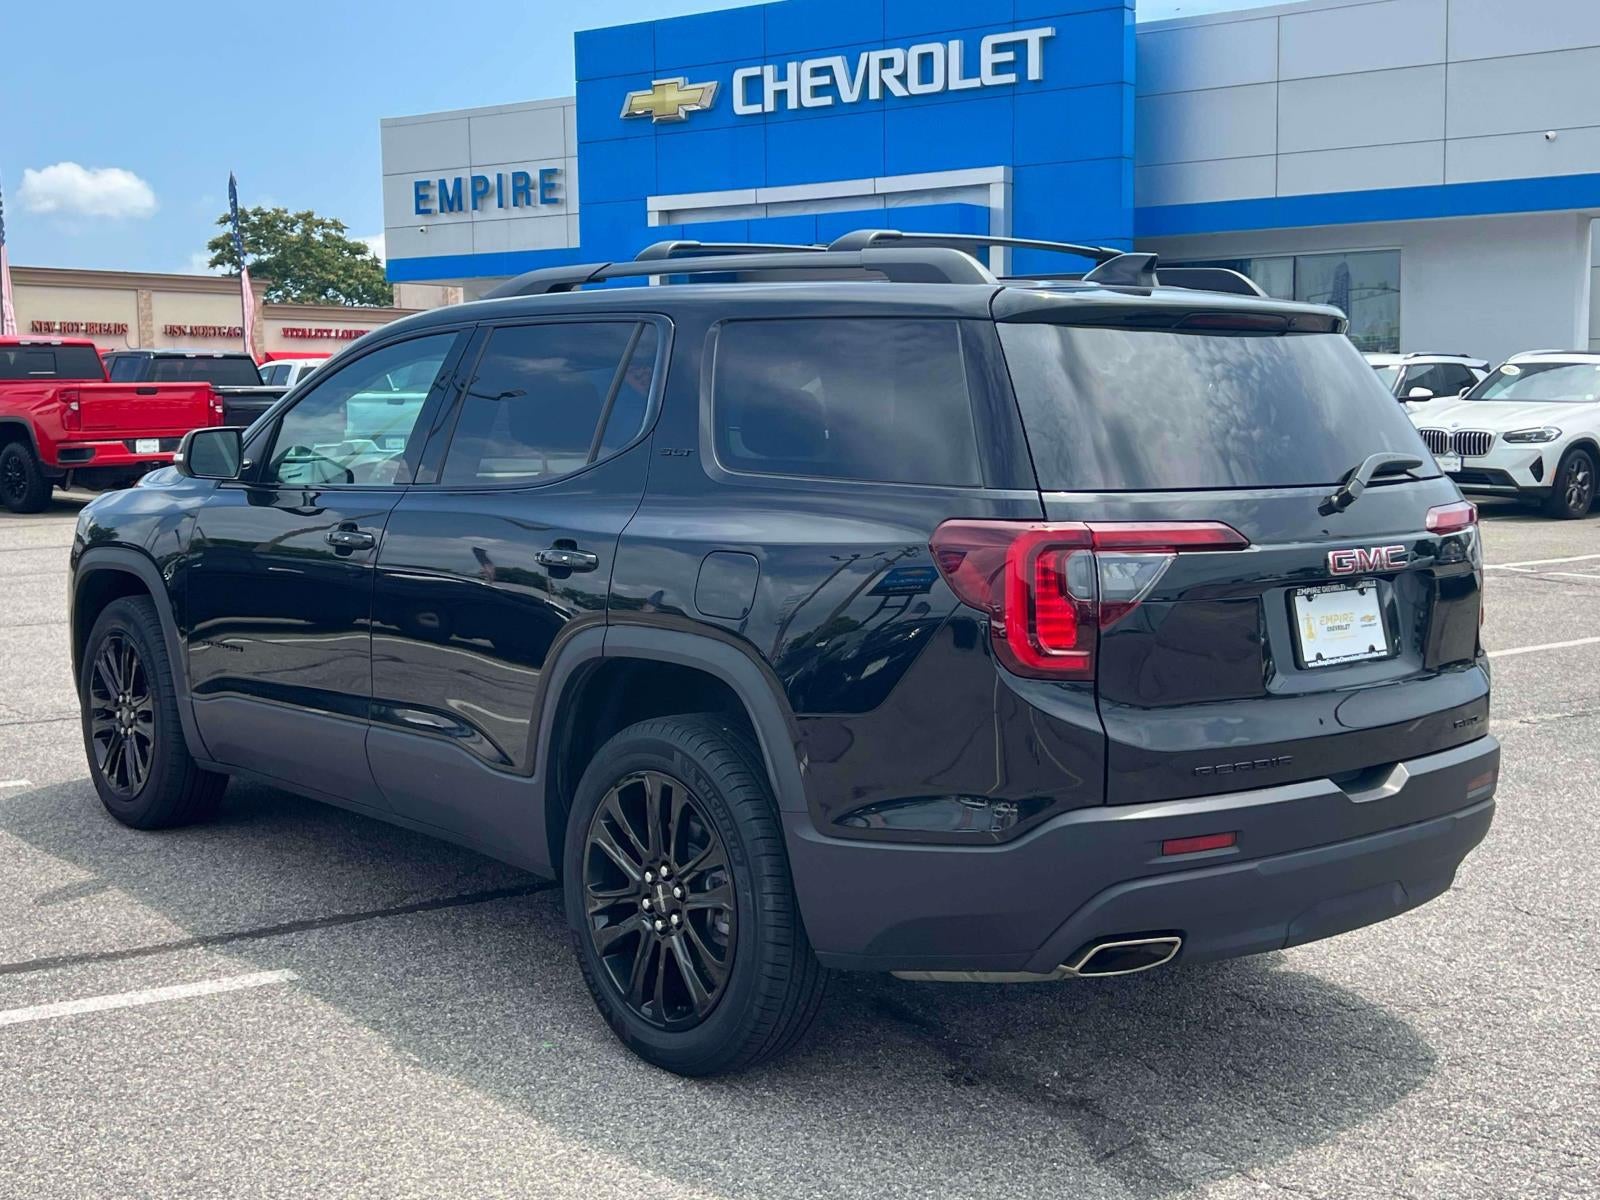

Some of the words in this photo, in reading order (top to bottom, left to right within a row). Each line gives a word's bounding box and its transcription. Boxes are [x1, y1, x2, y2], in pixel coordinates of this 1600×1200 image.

[732, 26, 1056, 117] CHEVROLET
[414, 167, 565, 216] EMPIRE
[31, 320, 56, 333] NEW
[60, 321, 83, 334] HOT
[86, 322, 129, 335] BREADS
[281, 327, 333, 339] VITALITY
[1328, 545, 1408, 576] GMC
[1319, 612, 1355, 625] EMPIRE
